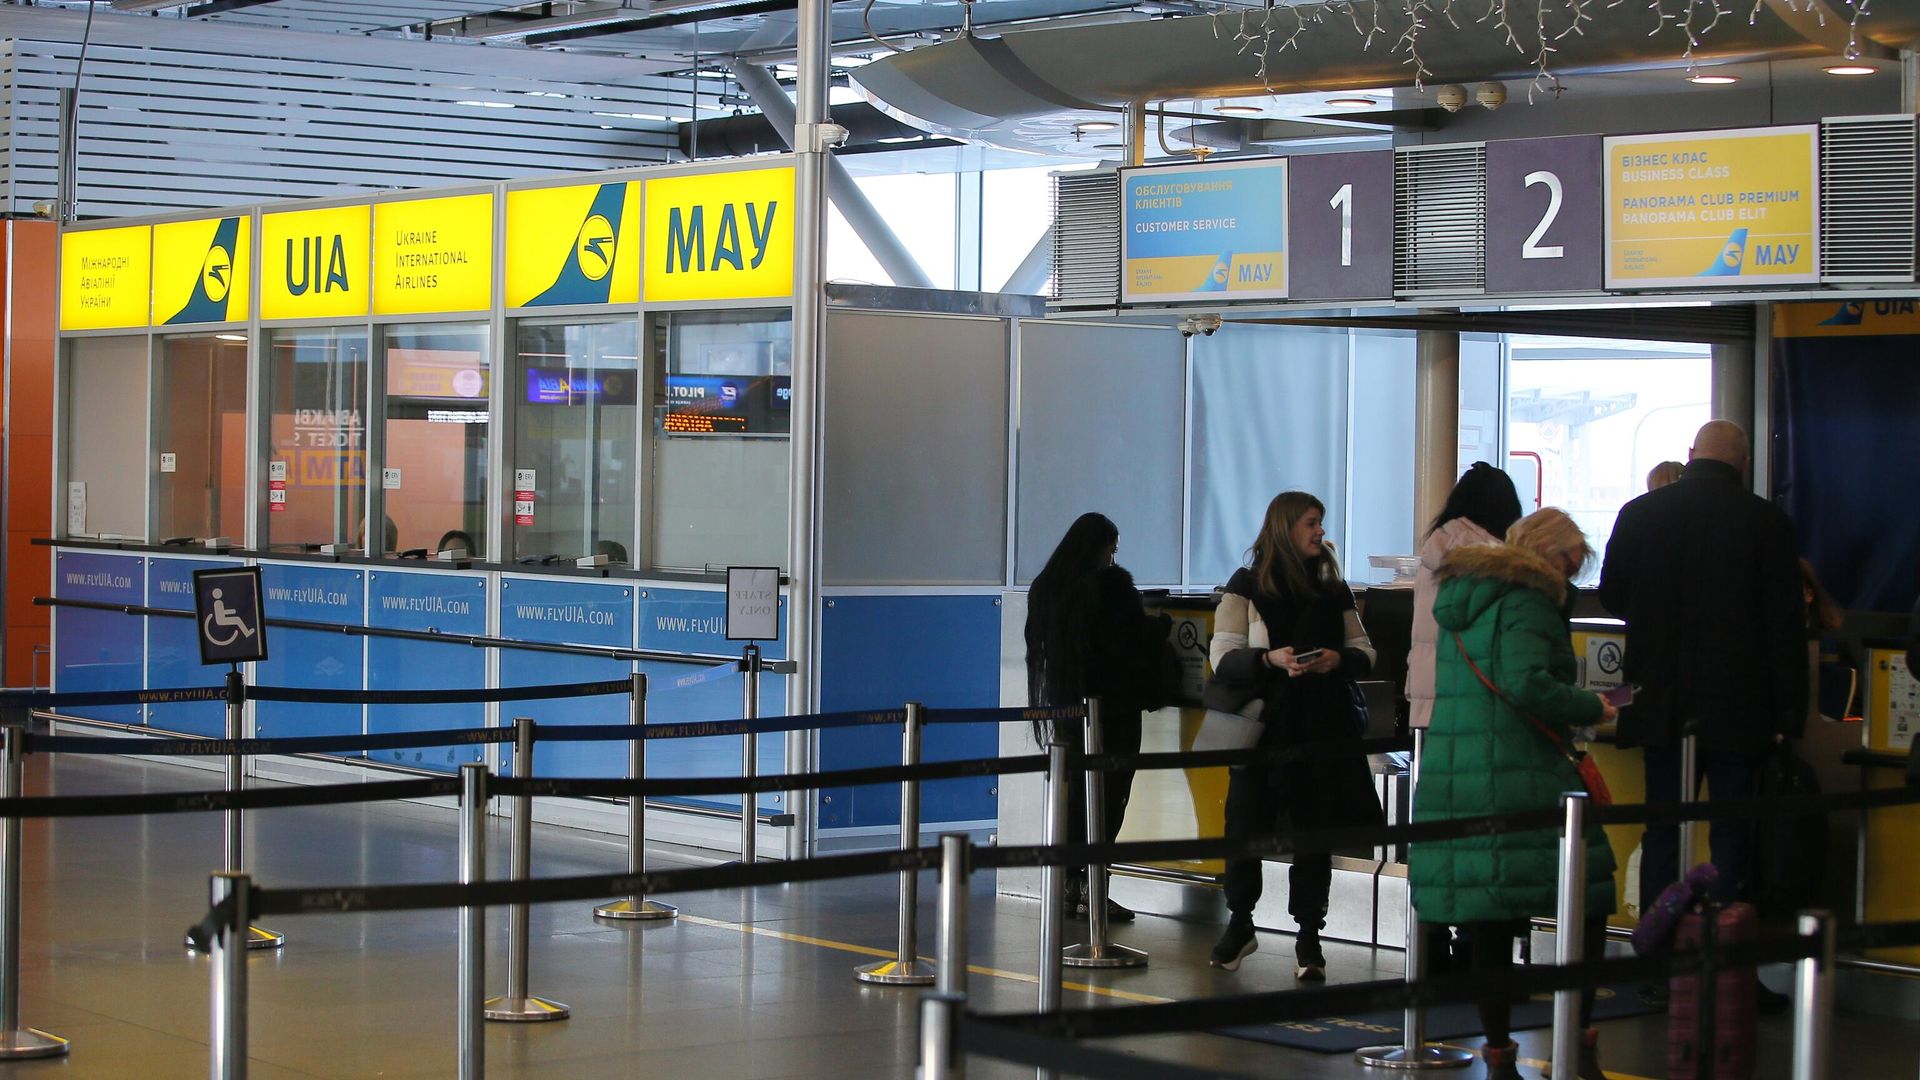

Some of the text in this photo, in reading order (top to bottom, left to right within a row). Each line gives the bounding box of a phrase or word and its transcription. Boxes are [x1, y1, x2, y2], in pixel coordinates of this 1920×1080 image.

[1622, 151, 1708, 167] БІЗНЕС КЛАС
[1622, 166, 1730, 182] BUSINESS CLASS
[1135, 180, 1233, 196] ОБСЛУГОВУВАННЯ
[1135, 197, 1183, 209] КЛІЄНТІВ
[1623, 190, 1799, 209] PANORAMA CLUB PREMIUM
[1522, 170, 1564, 259] 2
[1623, 207, 1767, 225] PANORAMA CLUB ELIT
[1135, 218, 1236, 233] CUSTOMER SERVICE
[1328, 183, 1353, 266] 1
[395, 229, 438, 247] UKRAINE
[665, 201, 777, 274] МАУ
[395, 251, 468, 268] INTERNATIONAL
[1755, 244, 1800, 266] МАУ
[286, 234, 349, 296] UIA
[1239, 263, 1273, 282] МАУ
[395, 273, 438, 290] AIRLINES
[656, 616, 727, 635] WWW.FLYUI
